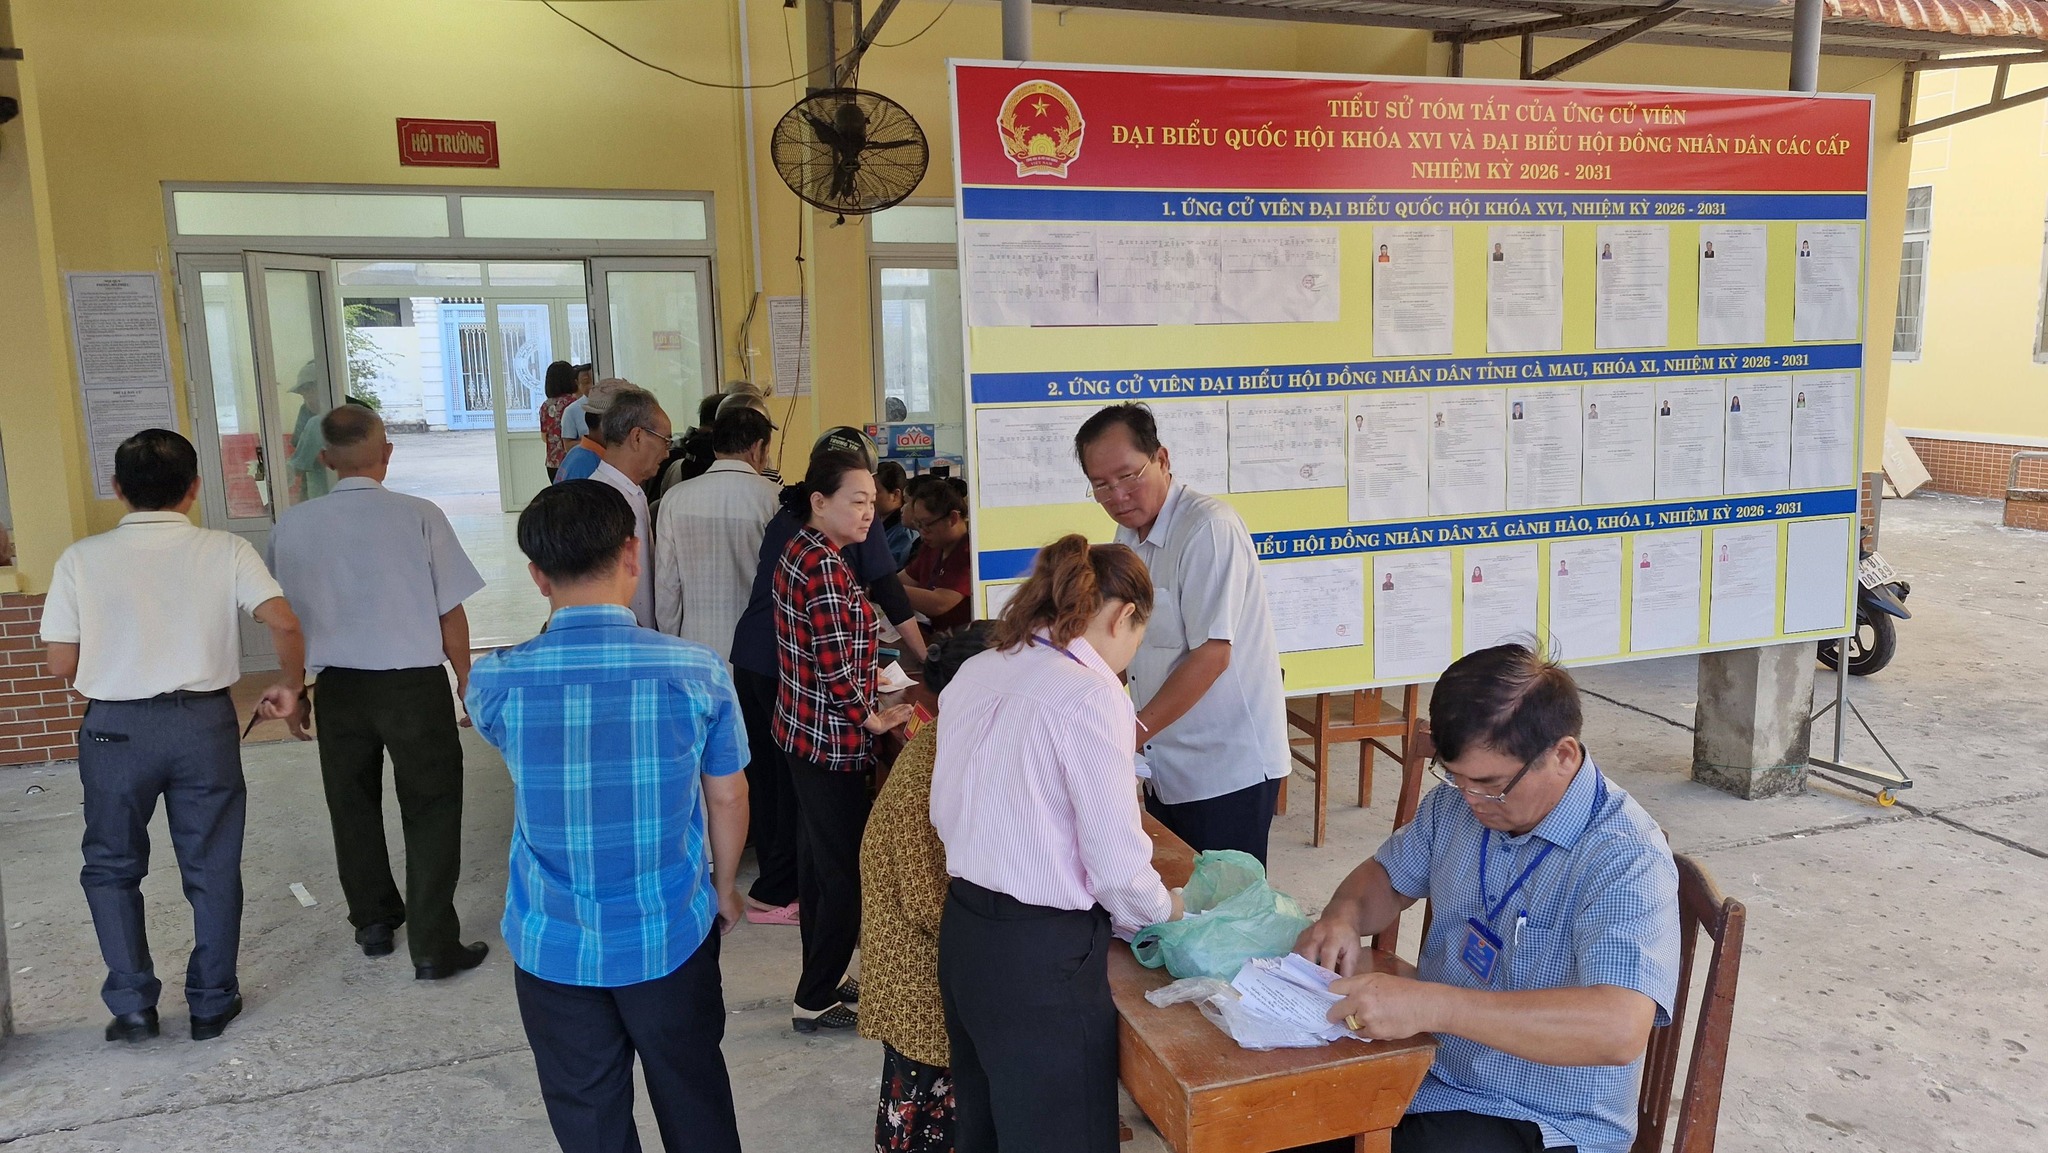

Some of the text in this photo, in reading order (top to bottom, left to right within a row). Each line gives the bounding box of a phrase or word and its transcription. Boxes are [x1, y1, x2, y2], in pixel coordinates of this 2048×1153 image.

[1328, 93, 1687, 124] TIỂU SỬ TÓM TẮT CỦA ỨNG CỬ VIÊN
[411, 128, 485, 156] HỘI TRƯỜNG
[1112, 119, 1850, 154] ĐẠI BIỂU QUỐC HỘI KHÓA XVI VÀ ĐẠI BIỂU HỘI ĐỒNG NHÂN DÂN CÁC CẤP
[1412, 158, 1480, 183] NHIỆM
[1487, 158, 1513, 179] KỲ
[1520, 164, 1558, 179] 2026
[1575, 164, 1611, 180] 2031
[1163, 202, 1175, 215] 1.
[1181, 197, 1222, 216] ỨNG
[1228, 196, 1254, 216] CỬ
[1259, 198, 1304, 215] VIÊN
[1310, 202, 1341, 218] ĐẠI
[1347, 196, 1390, 215] BIỂU
[1395, 199, 1443, 218] QUỐC
[1449, 199, 1479, 218] HỘI
[1485, 199, 1531, 215] KHÓA
[1536, 202, 1567, 217] XVI,
[1572, 199, 1624, 217] NHIỆM
[1630, 199, 1650, 214] KỲ
[1655, 203, 1685, 214] 2026
[1697, 203, 1726, 214] 2031
[1048, 382, 1062, 395] 2.
[1068, 377, 1110, 395] ỨNG
[1116, 374, 1143, 394] CỬ
[1148, 375, 1194, 392] VIÊN
[1200, 377, 1233, 392] ĐẠI
[1239, 369, 1283, 389] BIỂU
[1288, 370, 1321, 389] HỘI
[1327, 367, 1376, 385] ĐỒNG
[1382, 366, 1431, 383] NHÂN
[1436, 364, 1472, 381] DÂN
[1476, 362, 1517, 379] TỈNH
[1522, 361, 1543, 377] CÀ
[1548, 363, 1587, 377] MAU,
[1592, 358, 1636, 374] KHÓA
[1640, 360, 1659, 374] XI,
[1664, 355, 1714, 374] NHIỆM
[1718, 353, 1738, 369] KỲ
[1742, 356, 1770, 368] 2026
[1782, 354, 1808, 366] 2031
[1256, 535, 1287, 556] IỂU
[1293, 535, 1325, 552] HỘI
[1331, 529, 1380, 549] ĐỒNG
[1385, 527, 1433, 545] NHÂN
[1438, 525, 1473, 541] DÂN
[1478, 522, 1499, 538] XÃ
[1504, 520, 1550, 536] GÀNH
[1555, 516, 1592, 532] HÀO,
[1597, 512, 1640, 529] KHÓA
[1645, 514, 1654, 527] I,
[1659, 507, 1708, 526] NHIỆM
[1713, 504, 1732, 520] KỲ
[1736, 505, 1764, 518] 2026
[1776, 502, 1801, 514] 2031
